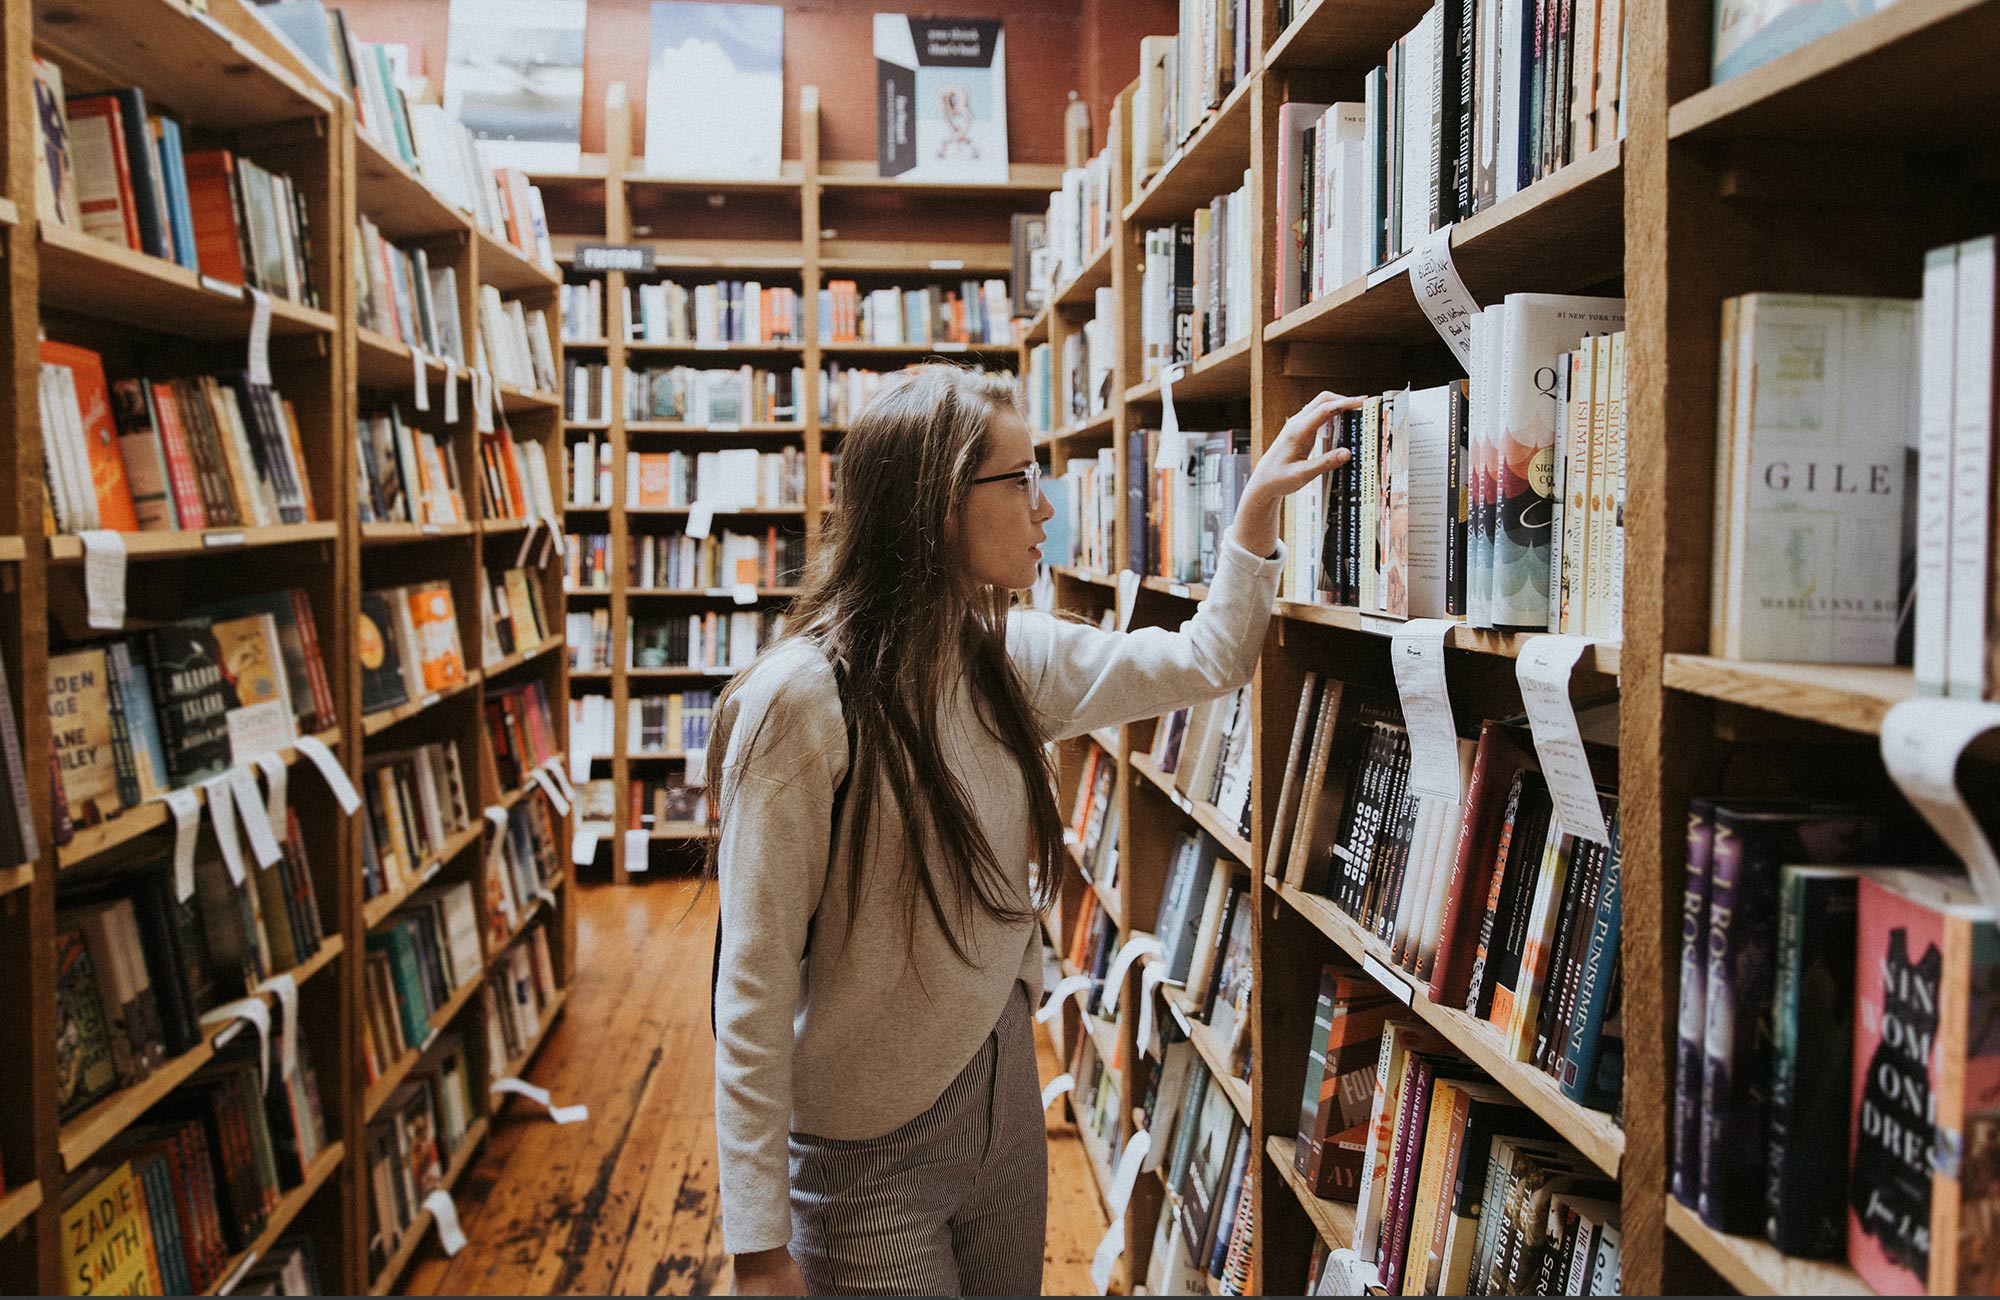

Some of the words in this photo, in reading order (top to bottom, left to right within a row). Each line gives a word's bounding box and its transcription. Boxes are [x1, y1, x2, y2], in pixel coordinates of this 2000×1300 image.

[1432, 57, 1441, 114] PYNCHON
[1461, 45, 1471, 105] PYNCHON
[1430, 122, 1440, 182] BLEEDING
[1460, 112, 1470, 174] BLEEDING
[1430, 185, 1439, 215] EDGE
[1459, 176, 1468, 209] EDGE
[1557, 311, 1567, 319] #1
[1450, 391, 1458, 455] Monument
[1575, 401, 1588, 474] ISHMAEL
[1592, 402, 1605, 477] ISHMAEL
[1607, 400, 1620, 476] ISHMAEL
[1479, 461, 1487, 519] MILLER'S
[1496, 455, 1505, 513] MILLER'S
[1764, 461, 1892, 495] GILE
[1553, 517, 1561, 544] Anna
[1573, 516, 1581, 554] DANIEL
[1590, 520, 1599, 558] DANIEL
[1604, 519, 1613, 558] DANIEL
[1551, 547, 1560, 600] Quindlen
[1613, 533, 1623, 579] DANIEL
[1571, 558, 1579, 594] QUINN
[1589, 563, 1597, 599] QUINN
[1602, 563, 1611, 600] QUINN
[1611, 584, 1620, 628] QUINN
[1384, 770, 1400, 834] IMPERFECTIONISTS
[1389, 773, 1407, 837] IMPERFECTIONISTS
[1466, 771, 1481, 809] Devil
[1351, 805, 1372, 881] OTARED
[1358, 809, 1380, 887] OTARED
[1450, 823, 1469, 886] Jerusalem
[1587, 847, 1595, 872] WHY
[1569, 857, 1581, 894] RAKHA
[1597, 851, 1605, 876] WHY
[1383, 865, 1396, 907] Rachman
[1392, 869, 1404, 911] Rachman
[1580, 879, 1589, 904] CAME
[1589, 883, 1599, 909] CAME
[1442, 896, 1453, 931] NAOMI
[1434, 934, 1446, 969] RAGEN
[1506, 916, 1517, 952] Childhood
[1513, 920, 1525, 957] Childhood
[1547, 933, 1566, 1002] CROCODILES
[1564, 957, 1574, 985] MARY
[1571, 918, 1609, 1053] PUNISHMENT
[1573, 962, 1583, 991] MARY
[1394, 1078, 1410, 1152] UNRESTORED
[1433, 1087, 1442, 1114] KNOW
[1443, 1097, 1454, 1124] KNOW
[1405, 1087, 1423, 1162] UNRESTORED
[1428, 1119, 1438, 1145] YOUR
[1438, 1131, 1449, 1159] YOUR
[1447, 1146, 1455, 1170] RON
[1388, 1155, 1399, 1200] WOMAN
[1398, 1167, 1410, 1211] WOMAN
[1441, 1171, 1451, 1201] RASH
[1484, 1154, 1496, 1190] Ron
[1493, 1164, 1505, 1199] Ron
[1506, 1174, 1519, 1209] THE
[1520, 1188, 1533, 1218] THE
[69, 1180, 133, 1255] ZADIE
[1382, 1205, 1393, 1245] SHOBHA
[1434, 1201, 1446, 1245] READER
[1484, 1206, 1498, 1249] Rash
[1578, 1225, 1590, 1247] THE
[1393, 1218, 1403, 1257] SHOBHA
[1495, 1214, 1511, 1269] RISEN
[1508, 1228, 1524, 1284] RISEN
[1563, 1235, 1572, 1260] RON
[78, 1220, 140, 1297] SMITH
[1477, 1264, 1485, 1290] ABOVE
[1556, 1262, 1567, 1293] RASH
[1569, 1249, 1585, 1295] WORLD
